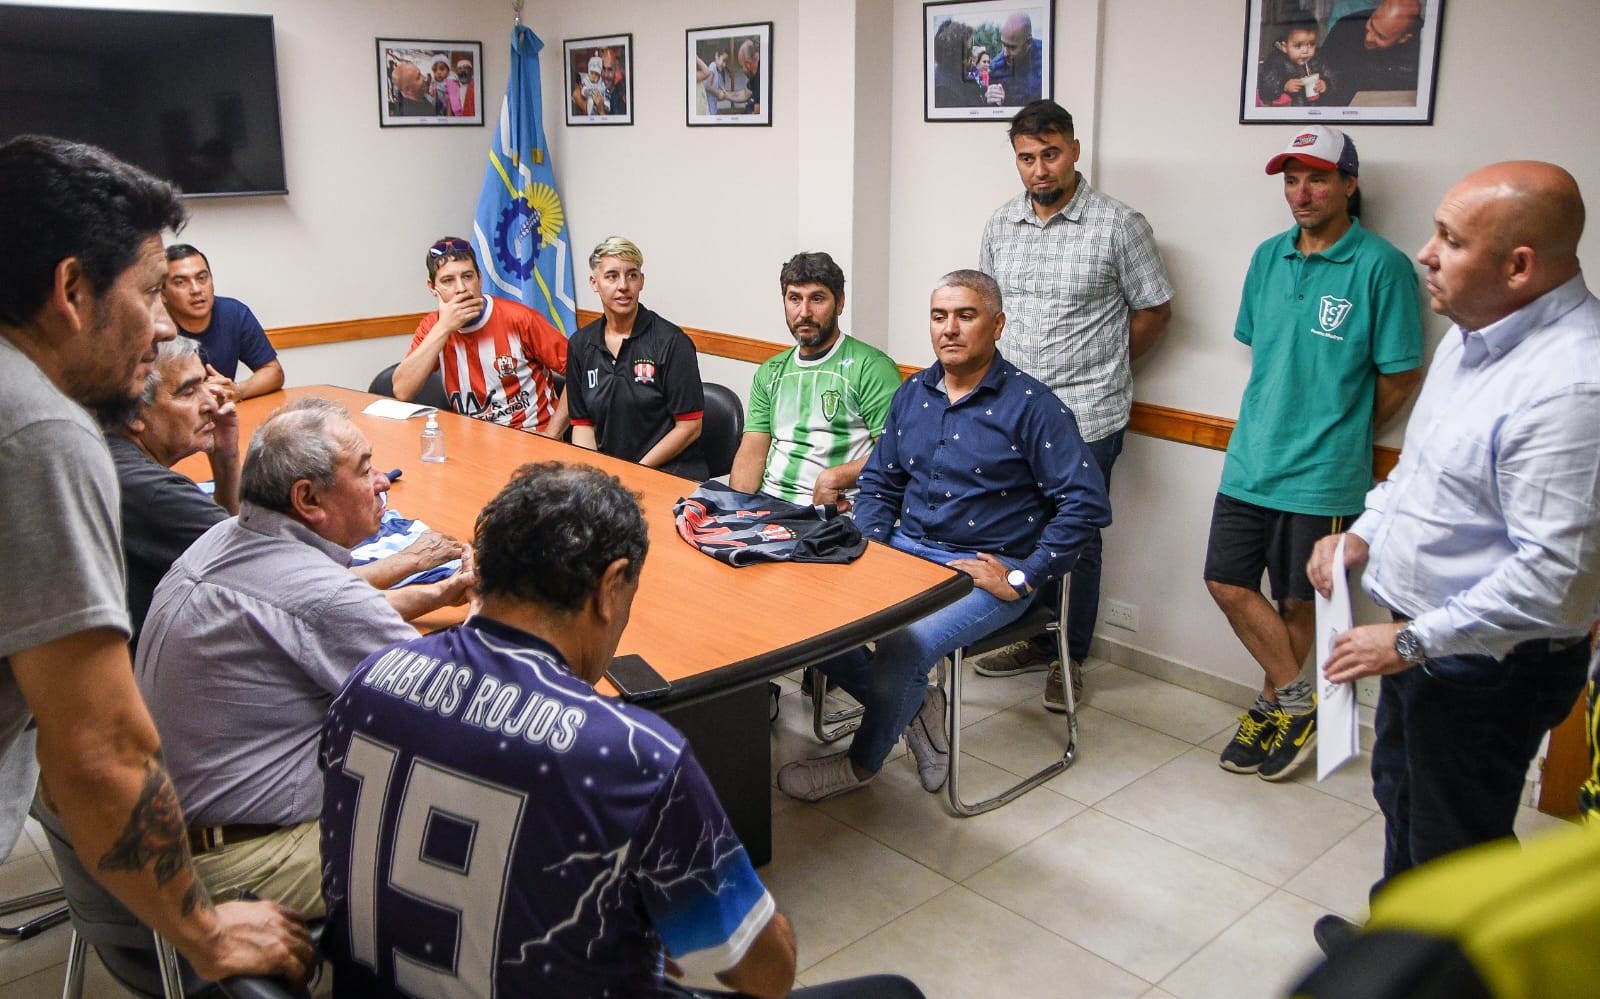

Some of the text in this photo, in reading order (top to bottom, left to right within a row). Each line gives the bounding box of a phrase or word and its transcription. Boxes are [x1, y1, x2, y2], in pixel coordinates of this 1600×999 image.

[362, 649, 587, 753] DIABLOS ROJOS
[342, 731, 529, 999] 19
